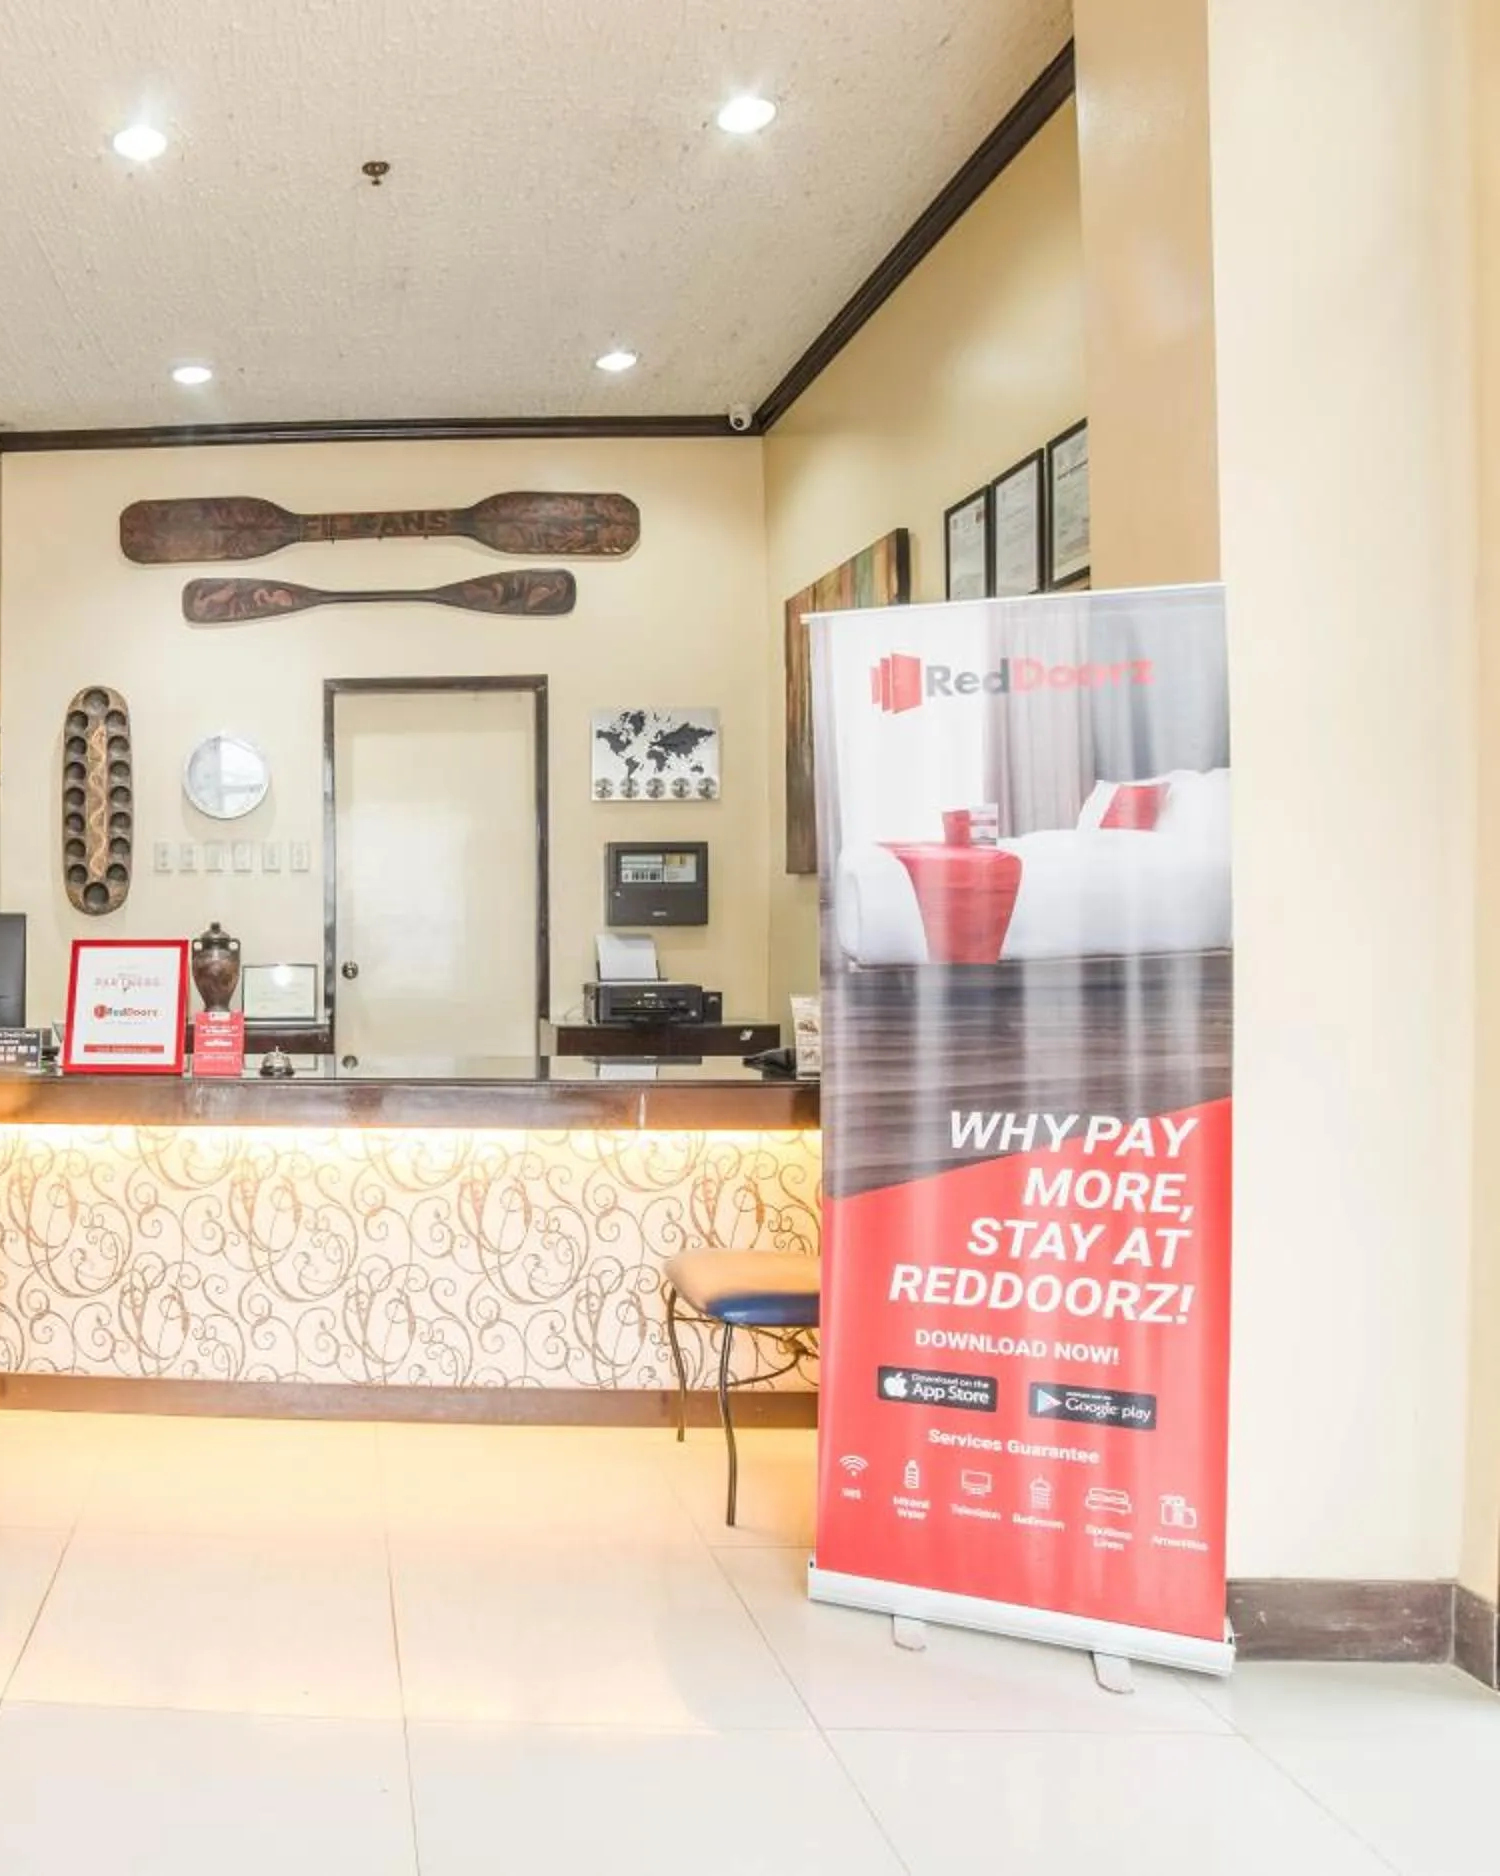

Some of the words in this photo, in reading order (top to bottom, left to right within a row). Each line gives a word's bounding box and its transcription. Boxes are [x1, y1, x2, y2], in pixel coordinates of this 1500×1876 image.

[925, 657, 1155, 698] RedDoorz
[950, 1110, 1079, 1153] WHY
[1083, 1115, 1199, 1158] PAY
[1022, 1167, 1195, 1223] MORE,
[967, 1217, 1106, 1263] STAY
[1112, 1226, 1194, 1269] AT
[888, 1263, 1196, 1325] REDDOORZ!
[915, 1329, 1048, 1359] DOWNLOAD
[1054, 1342, 1120, 1366] NOW!
[911, 1373, 959, 1386] Download
[912, 1382, 945, 1402] App
[948, 1385, 990, 1405] Store
[1065, 1397, 1120, 1418] Google
[1121, 1404, 1152, 1423] play
[928, 1428, 1003, 1452] Services
[1007, 1439, 1100, 1464] Guarantee
